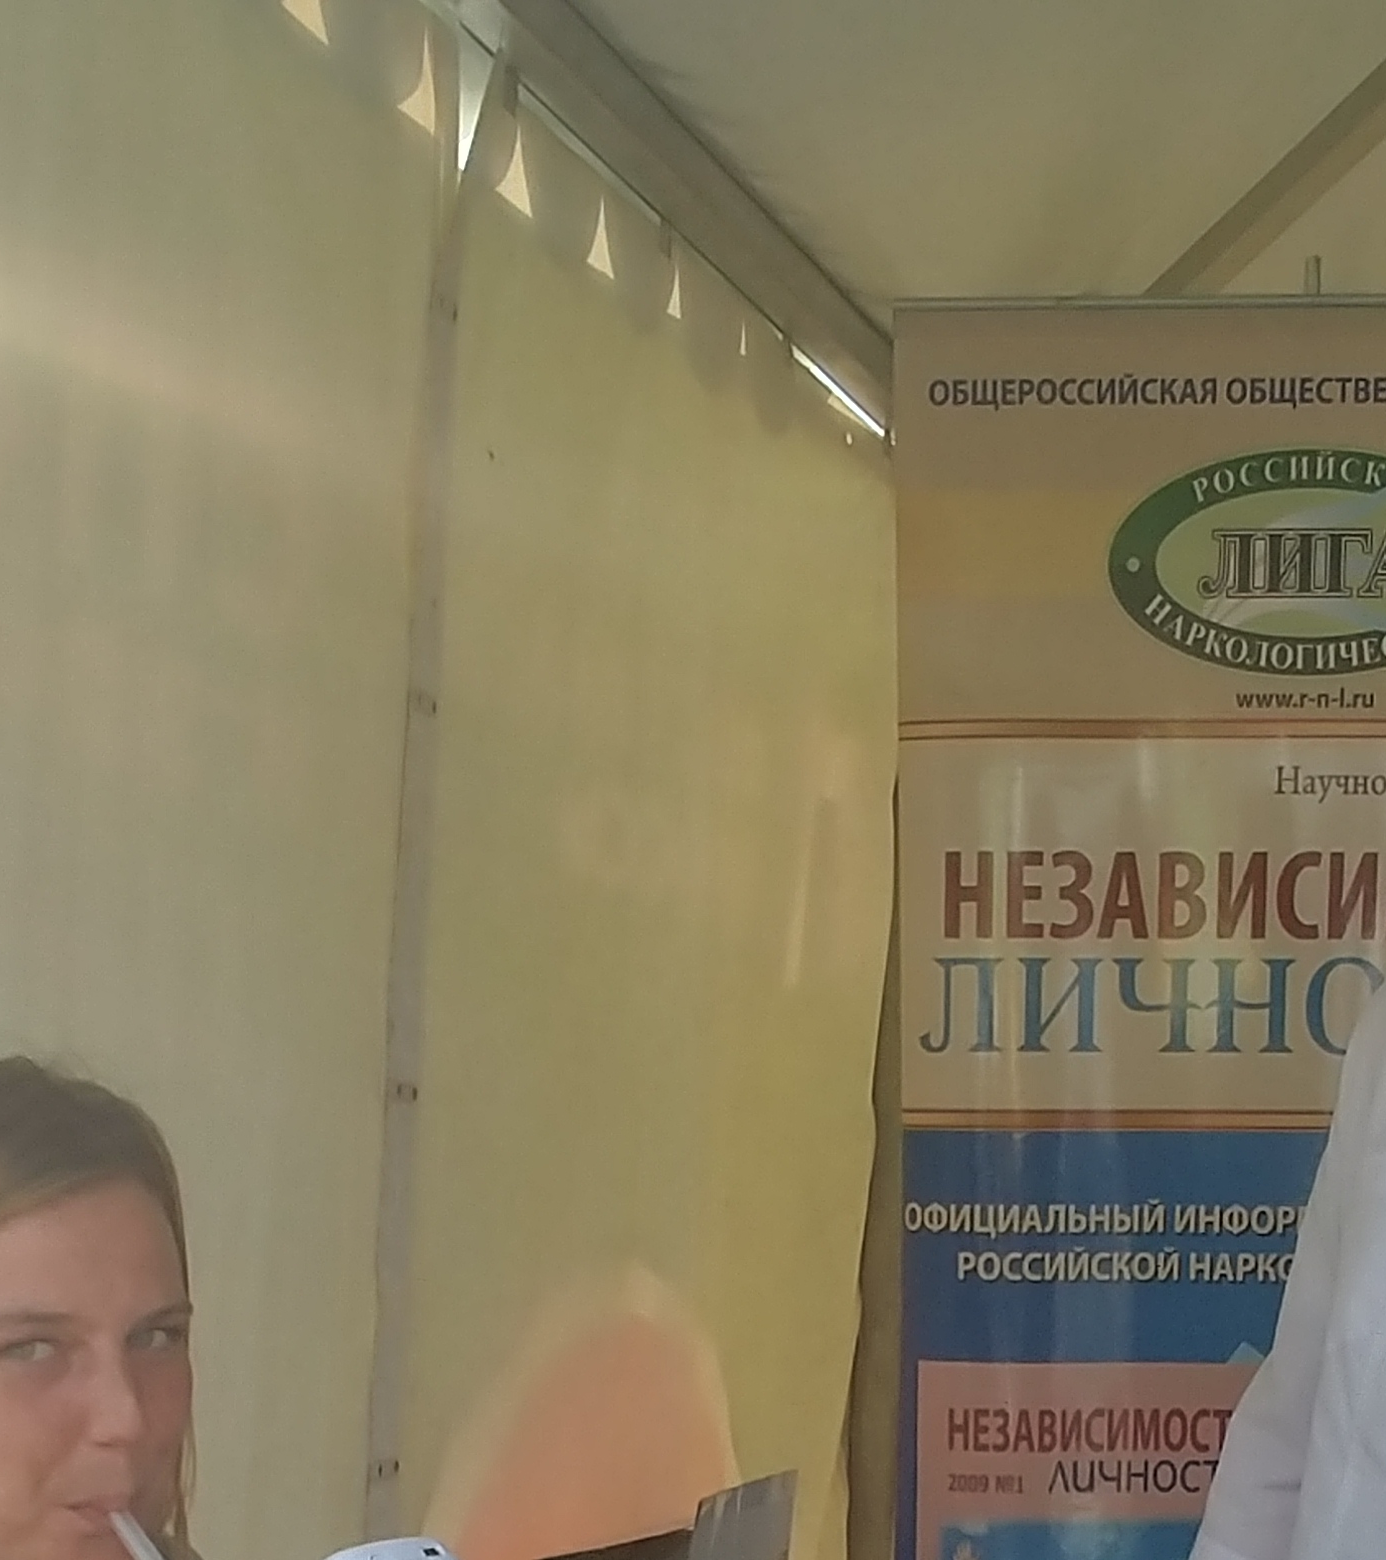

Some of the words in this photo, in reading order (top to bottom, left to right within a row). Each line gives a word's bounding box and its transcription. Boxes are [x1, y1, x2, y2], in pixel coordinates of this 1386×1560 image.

[928, 374, 1216, 411] ОБЩЕРОССИЙСКАЯ
[1236, 688, 1374, 709] www.r-n-l.ru
[905, 1200, 1165, 1238] ОФИЦИАЛЬНЫЙ
[1174, 1203, 1307, 1236] ИНФОР
[958, 1246, 1179, 1282] РОССИЙСКОЙ
[948, 1408, 1232, 1452] НЕЗАВИСИМОСТ
